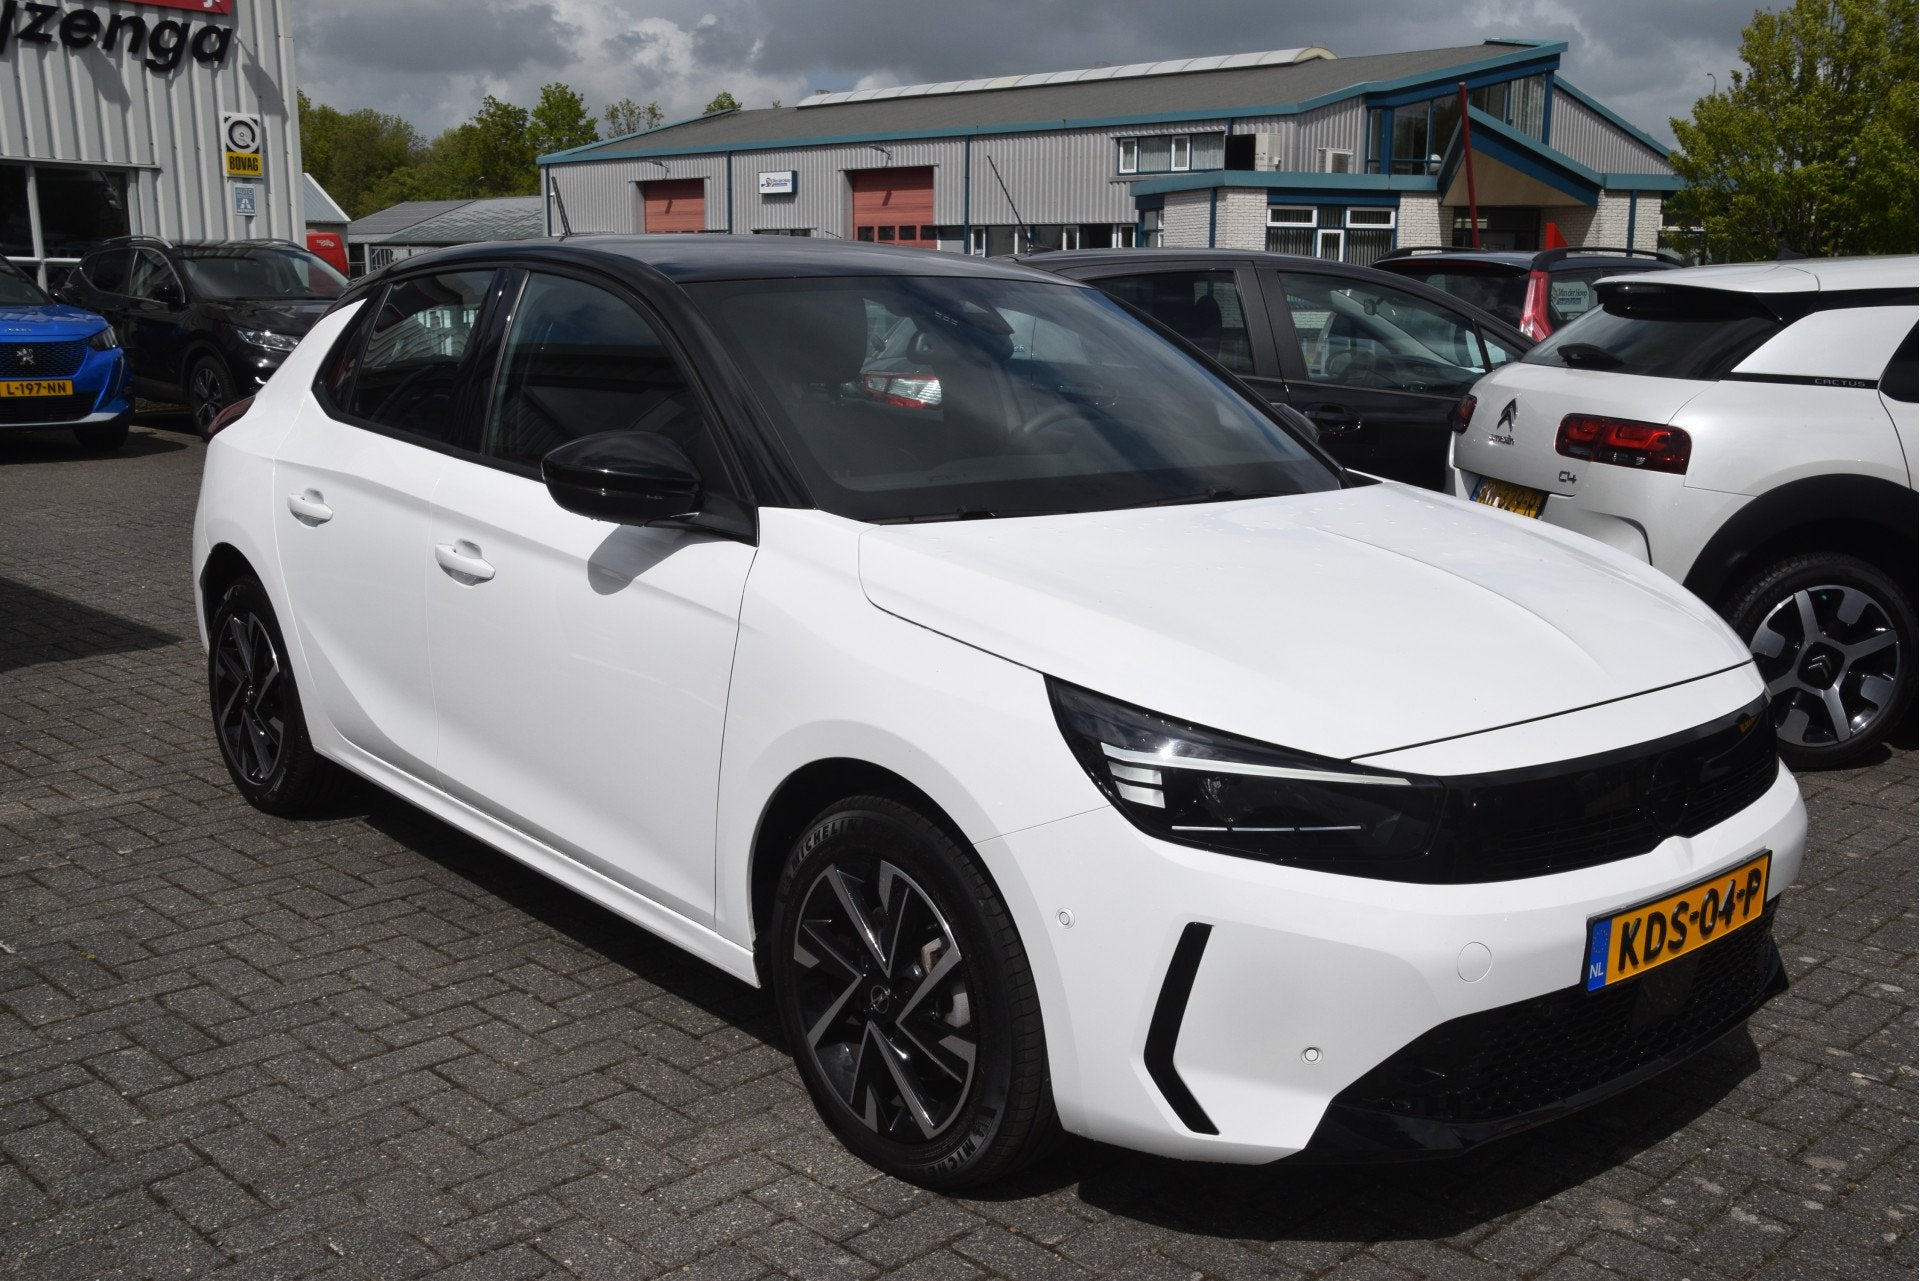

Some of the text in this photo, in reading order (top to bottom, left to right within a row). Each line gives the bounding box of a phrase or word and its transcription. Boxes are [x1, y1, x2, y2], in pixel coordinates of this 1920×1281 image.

[230, 157, 259, 171] BOVAG
[6, 382, 67, 395] L-197-NN
[1814, 378, 1866, 387] CACTUS
[1559, 471, 1577, 484] C4
[791, 816, 859, 872] MICHELIN
[1618, 868, 1762, 972] KDS-04-P
[1589, 961, 1605, 979] NL
